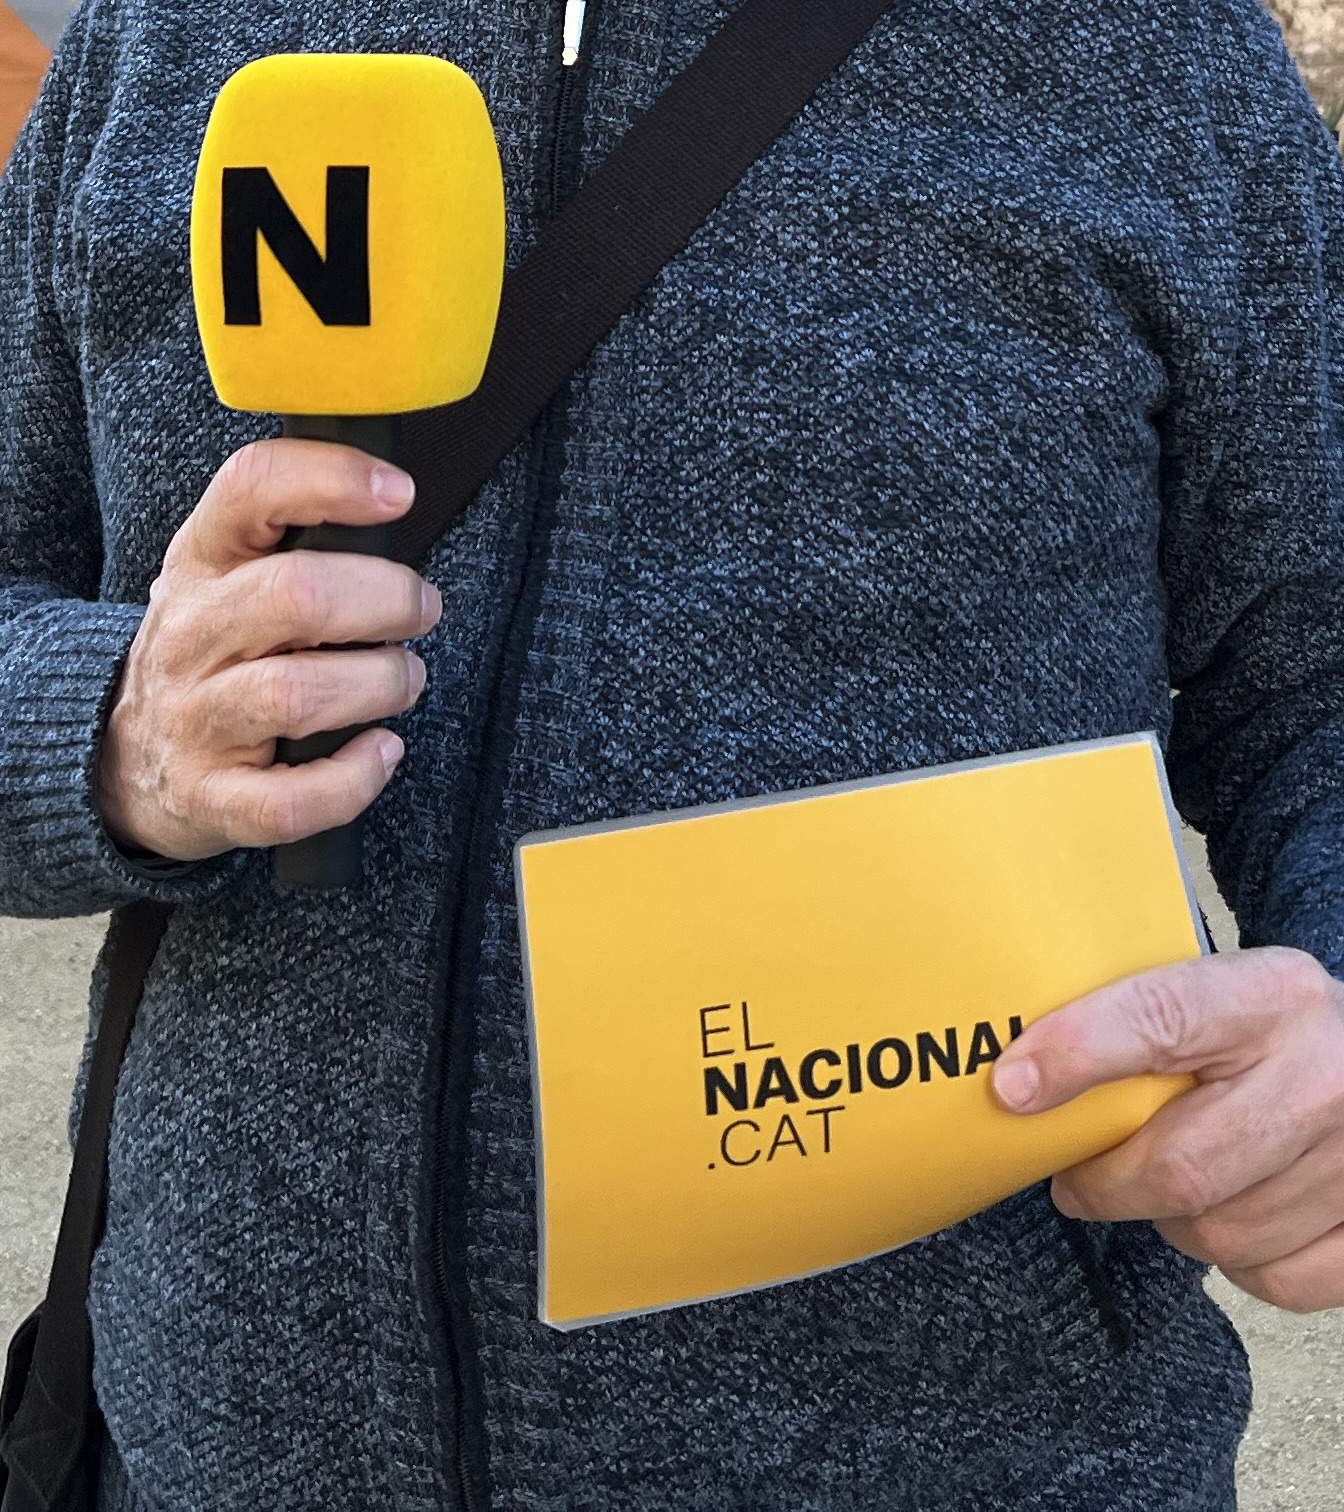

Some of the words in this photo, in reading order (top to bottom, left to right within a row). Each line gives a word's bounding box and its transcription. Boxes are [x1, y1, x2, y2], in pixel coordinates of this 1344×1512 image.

[221, 165, 371, 327] N
[699, 1002, 775, 1059] EL
[707, 1106, 846, 1170] .CAT
